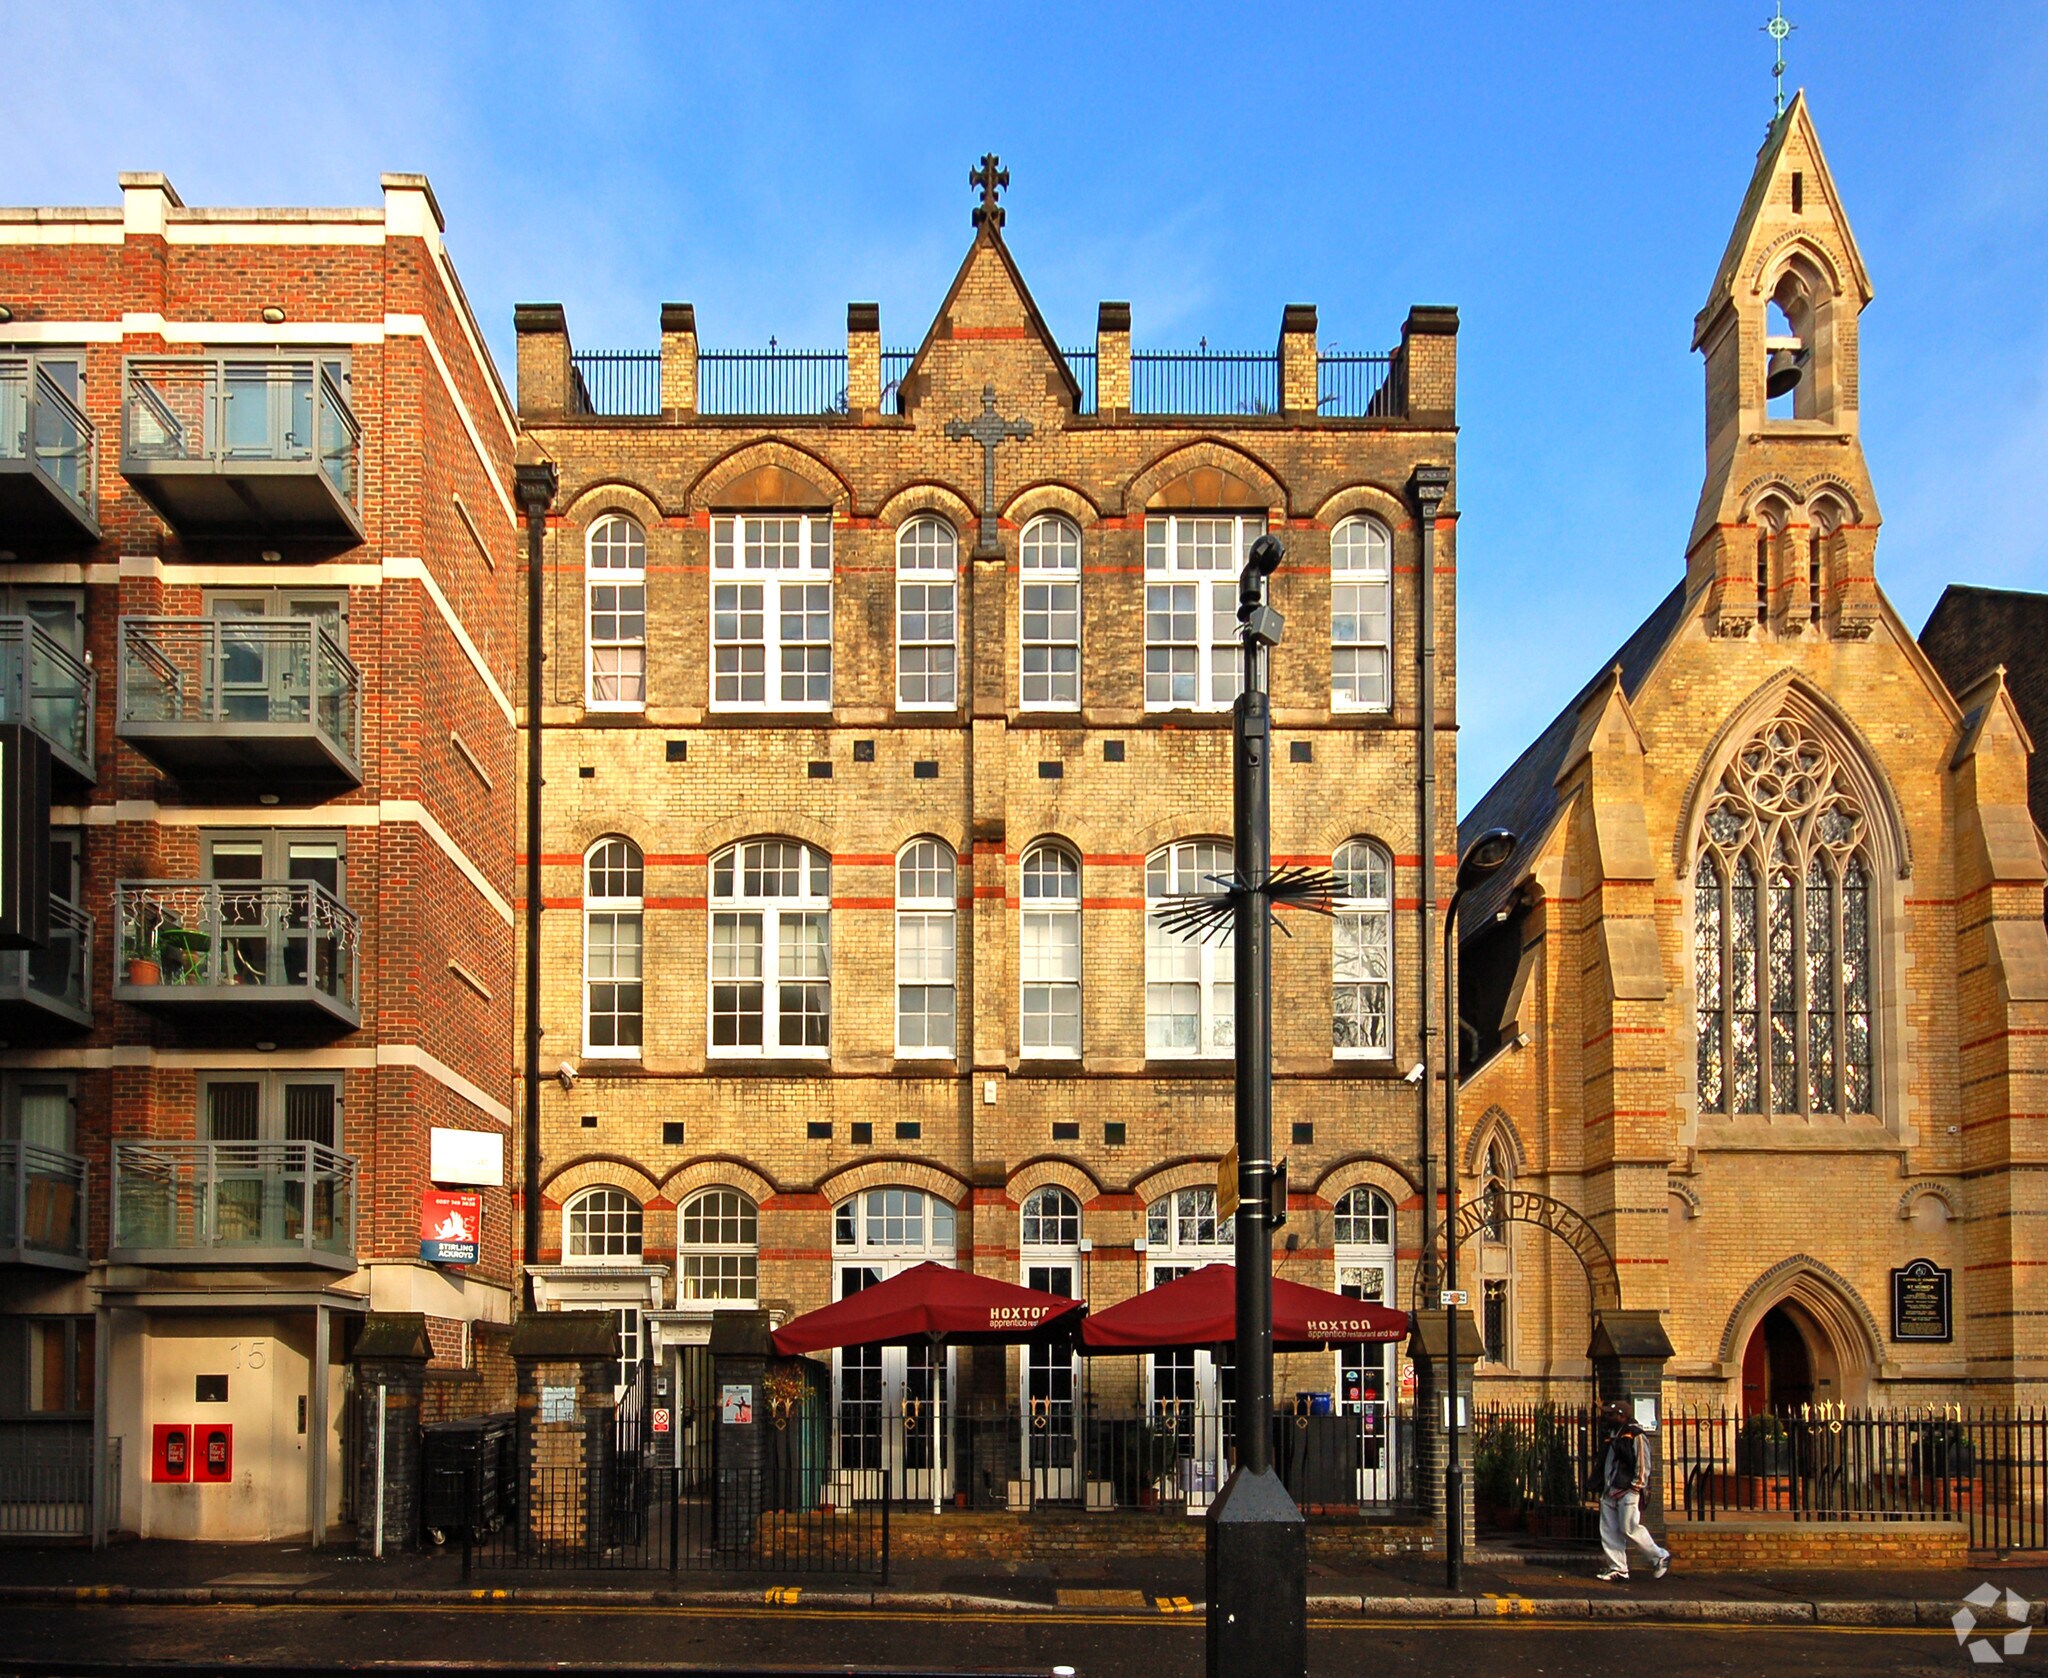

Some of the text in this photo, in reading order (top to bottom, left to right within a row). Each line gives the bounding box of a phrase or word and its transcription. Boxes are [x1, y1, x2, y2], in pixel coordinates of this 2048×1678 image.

[438, 1242, 474, 1252] STIRLING
[438, 1250, 474, 1259] ACKROYD
[581, 1281, 621, 1291] BOYS
[989, 1319, 1028, 1329] apprentice
[1307, 1330, 1347, 1340] apprentice
[230, 1341, 266, 1370] 15
